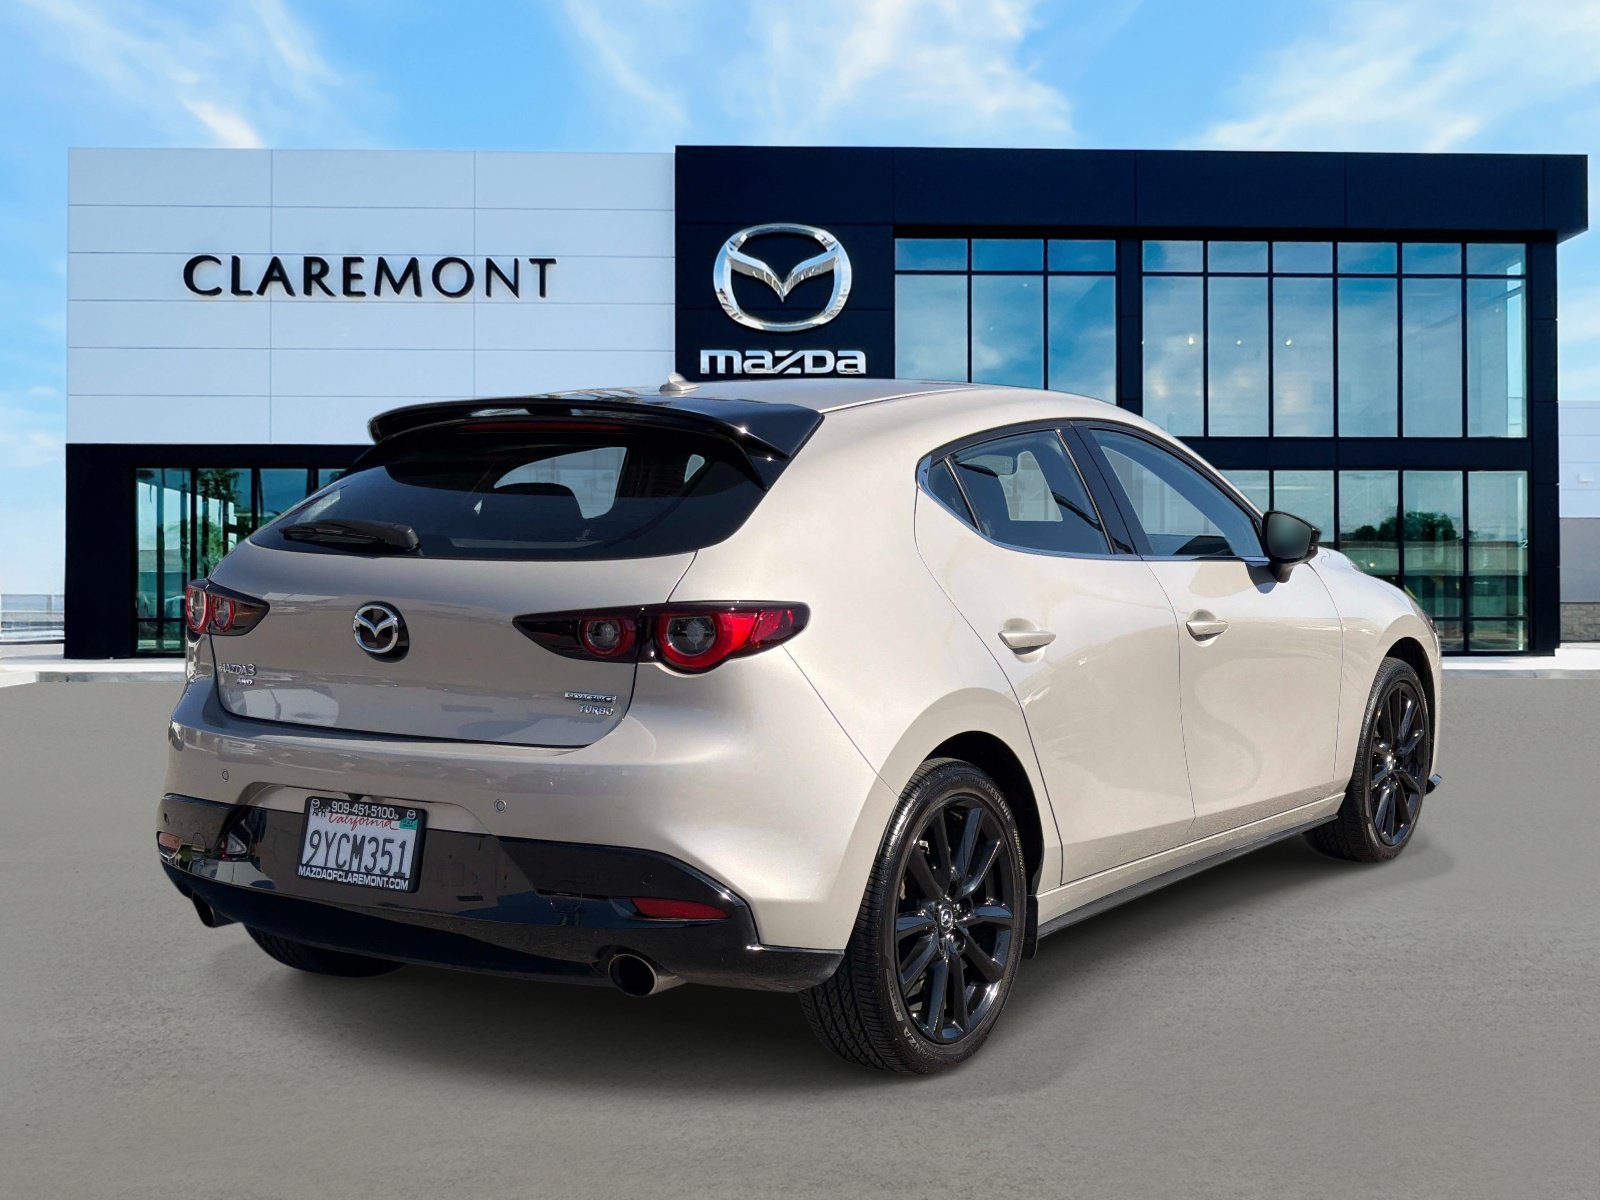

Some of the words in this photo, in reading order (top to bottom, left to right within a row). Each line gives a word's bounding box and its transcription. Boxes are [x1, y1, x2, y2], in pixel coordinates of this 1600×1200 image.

[183, 254, 558, 298] CLAREMONT
[579, 703, 614, 716] TURBO
[329, 812, 400, 831] California
[331, 801, 395, 820] 909-451-5100
[305, 829, 407, 877] 9YCM351
[298, 865, 409, 890] MAZDAOFCLAREMONT.COM
